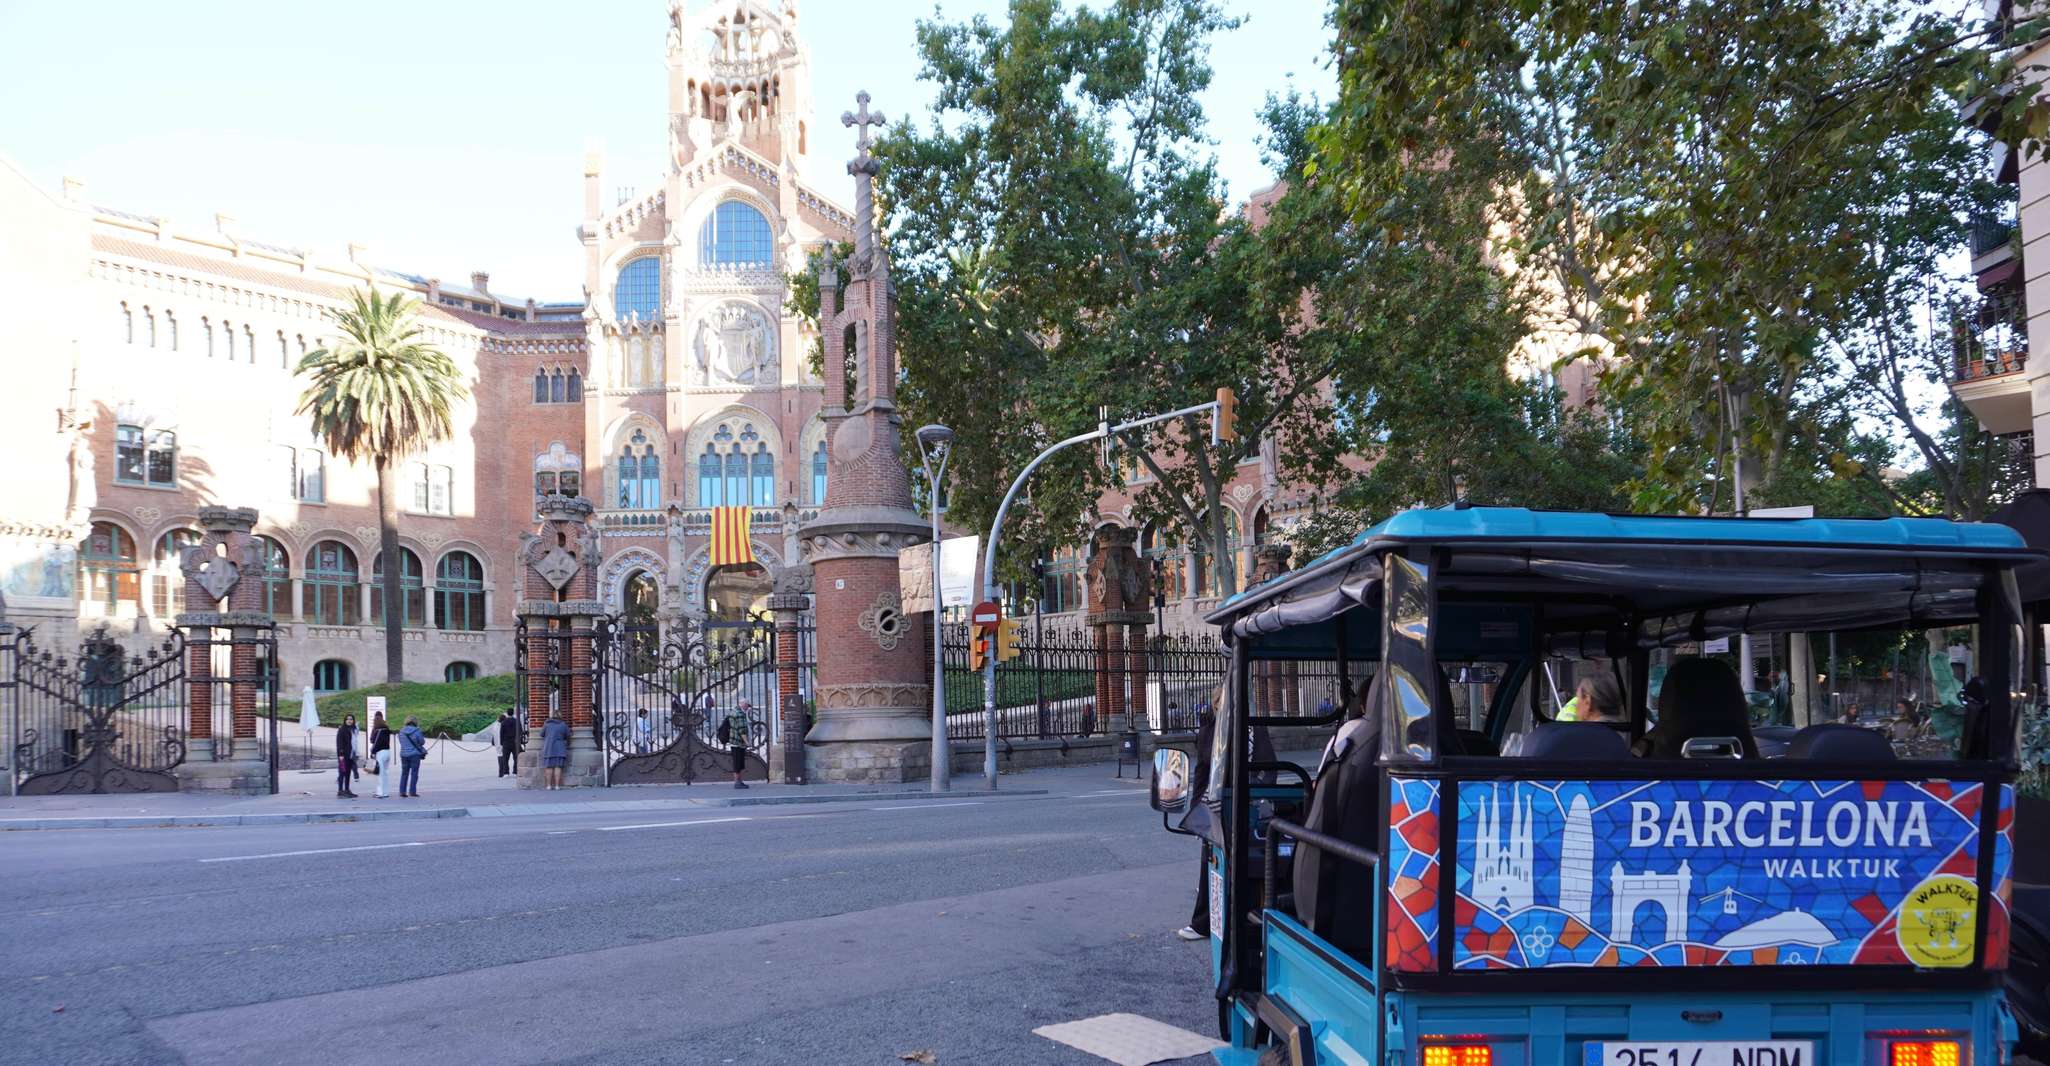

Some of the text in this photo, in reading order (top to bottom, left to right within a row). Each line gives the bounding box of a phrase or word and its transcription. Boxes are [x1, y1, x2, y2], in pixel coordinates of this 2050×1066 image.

[1629, 800, 1933, 848] BARCELONA
[1763, 858, 1901, 879] WALKTUK
[1916, 883, 1977, 906] WALKTUK
